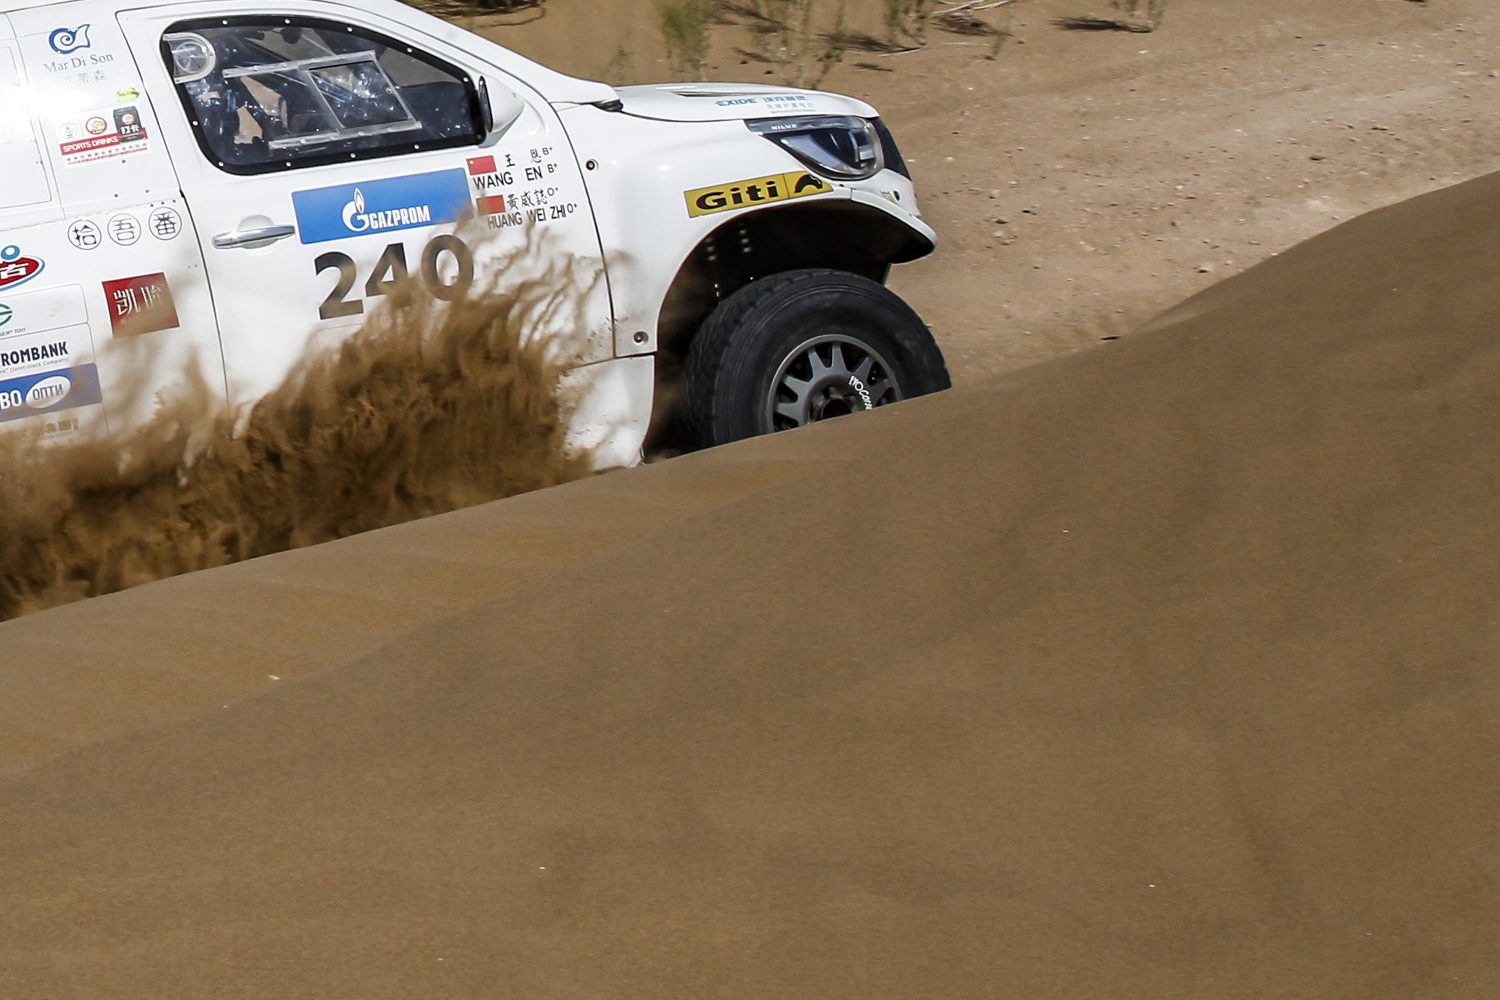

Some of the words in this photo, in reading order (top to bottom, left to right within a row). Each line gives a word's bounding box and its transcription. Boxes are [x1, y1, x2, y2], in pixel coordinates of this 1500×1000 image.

[43, 61, 69, 73] Mar
[70, 56, 87, 69] Di
[89, 53, 114, 65] Son
[715, 98, 757, 107] EXIDE
[62, 140, 92, 153] SPORTS
[92, 135, 119, 149] DRINKS
[473, 171, 514, 190] WANG
[525, 166, 543, 181] EN
[696, 180, 779, 210] Giti
[369, 204, 431, 229] GAZPROM
[487, 211, 523, 230] HUANG
[526, 208, 546, 222] WEI
[549, 204, 567, 220] ZHI
[314, 234, 474, 320] 240
[32, 383, 64, 400] ОПТИ
